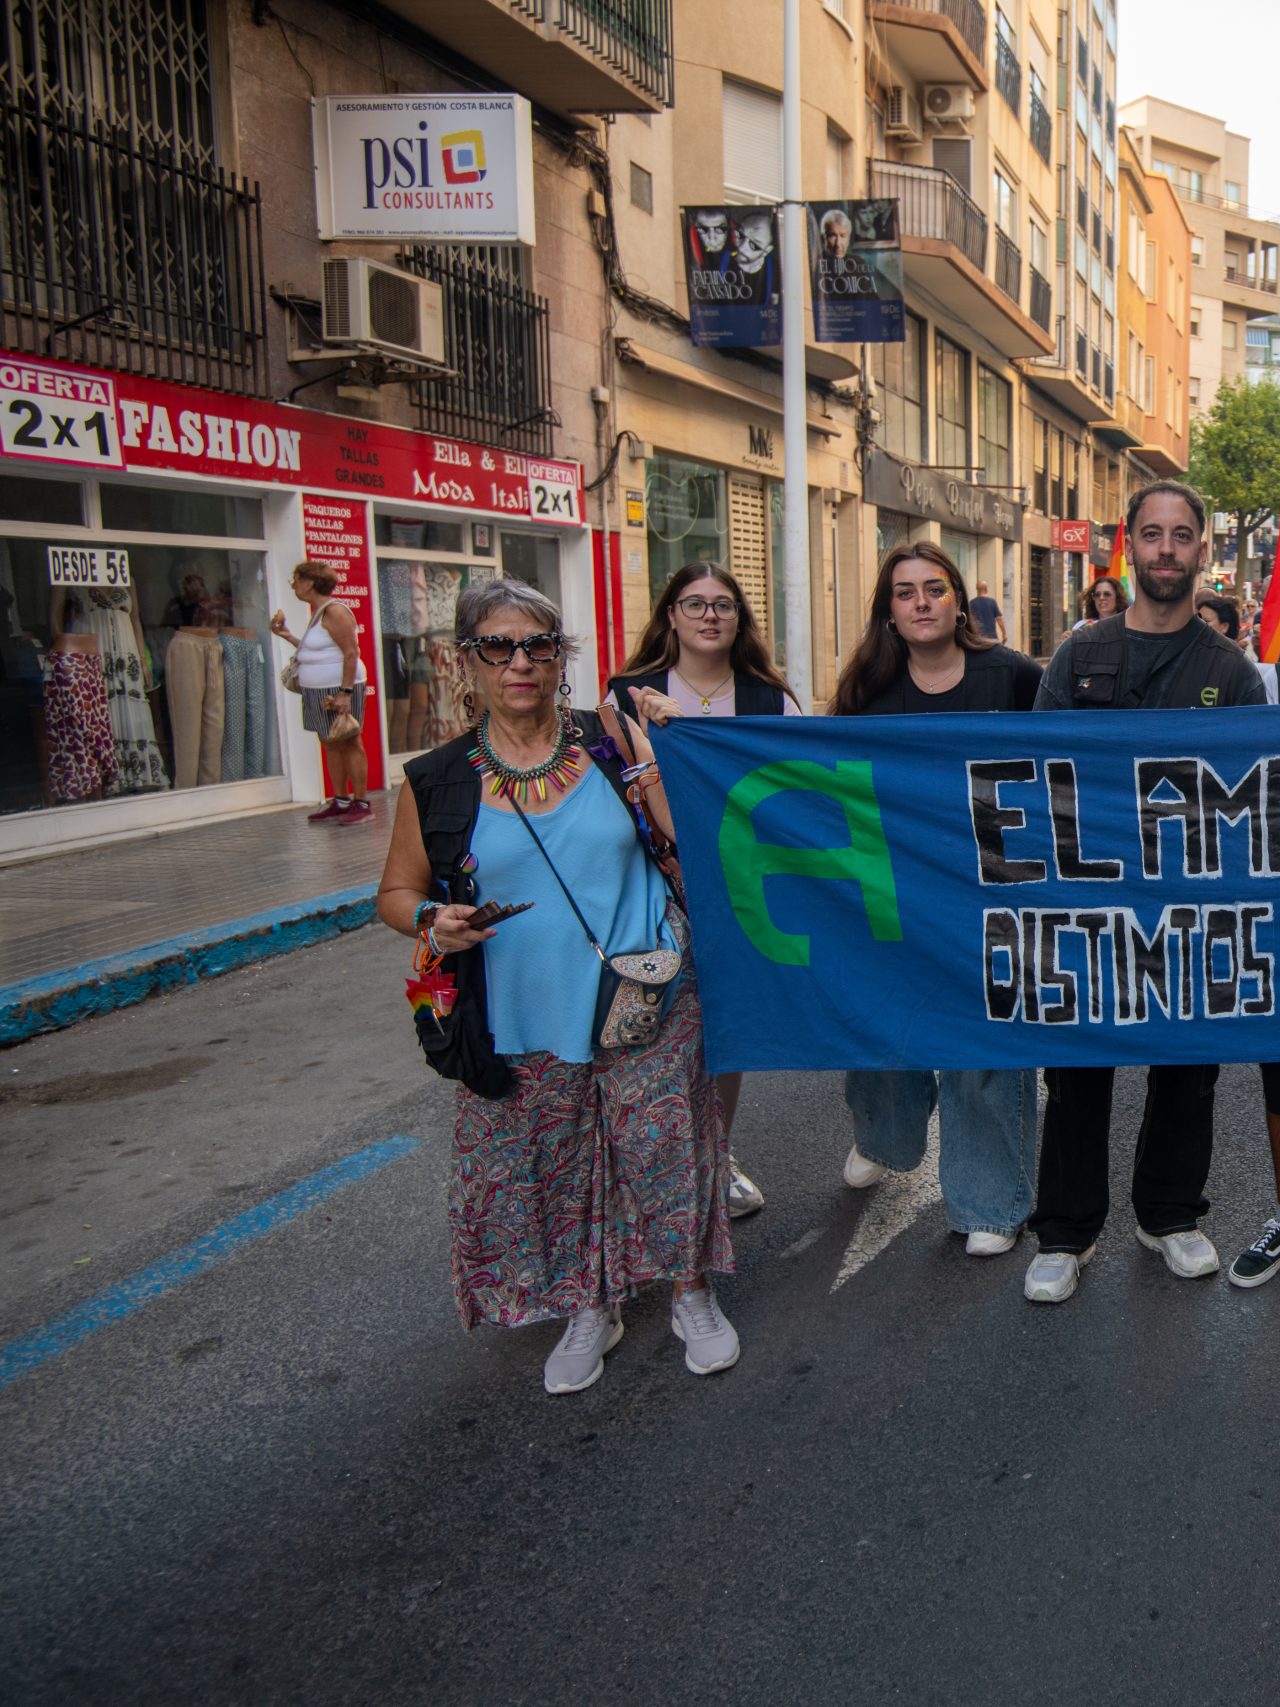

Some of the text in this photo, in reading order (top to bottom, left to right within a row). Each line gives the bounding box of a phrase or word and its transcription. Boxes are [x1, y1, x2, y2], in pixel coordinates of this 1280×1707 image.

[336, 101, 513, 112] ASESORAMIENTO Y GESTIÓN COSTA BLANCA
[360, 120, 433, 209] psi
[383, 191, 494, 209] CONSULTANTS
[819, 258, 832, 274] EL
[1, 367, 108, 404] OFERTA
[9, 399, 110, 456] 2x1
[119, 399, 301, 471] FASHION
[347, 427, 368, 442] HAY
[340, 446, 379, 466] TALLAS
[433, 441, 527, 477] Ella & Ell
[335, 468, 385, 489] GRANDES
[412, 469, 530, 510] Moda Itali
[529, 463, 576, 485] OFERTA
[534, 485, 575, 518] 2x1
[52, 550, 128, 585] DESDE 5€
[349, 547, 361, 557] DE
[341, 586, 368, 596] LARGAS
[968, 756, 1122, 886] EL
[980, 899, 1275, 1026] DISTINTOS
